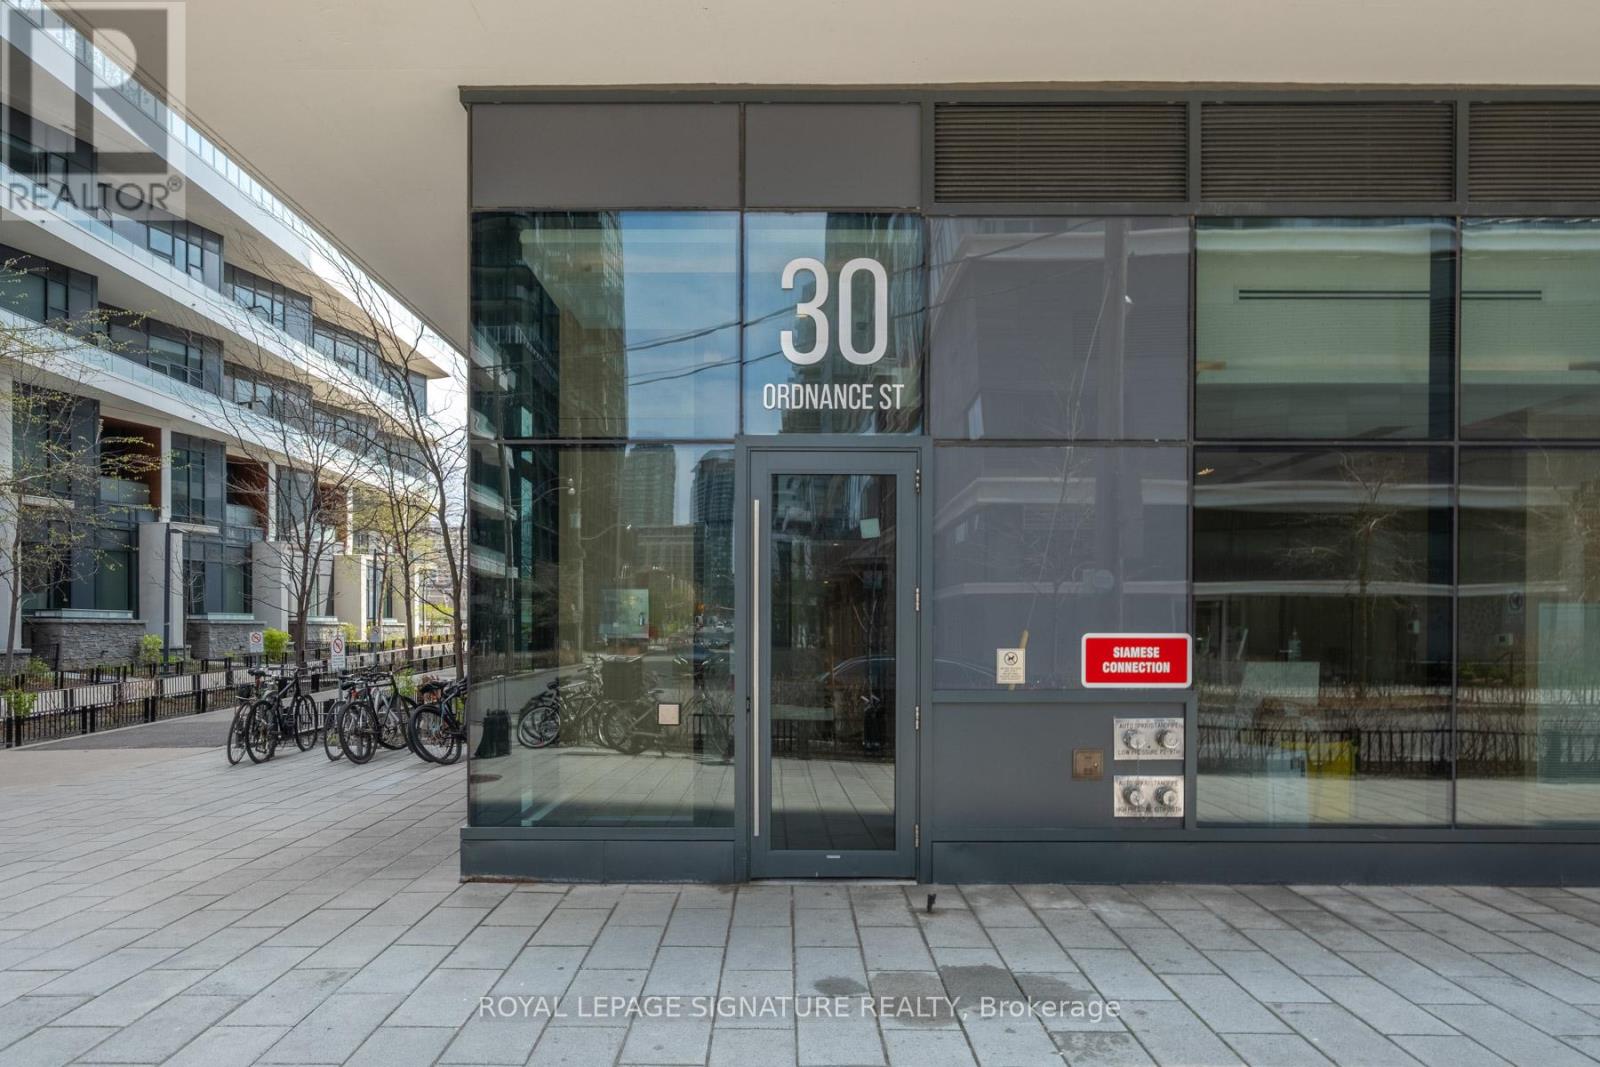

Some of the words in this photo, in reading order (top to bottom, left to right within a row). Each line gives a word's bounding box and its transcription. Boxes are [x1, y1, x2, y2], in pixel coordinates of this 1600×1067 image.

[780, 257, 888, 366] 30
[763, 383, 873, 410] ORDNANCE
[879, 383, 904, 410] ST
[1112, 646, 1160, 658] SIAMESE
[1102, 661, 1170, 673] CONNECTION
